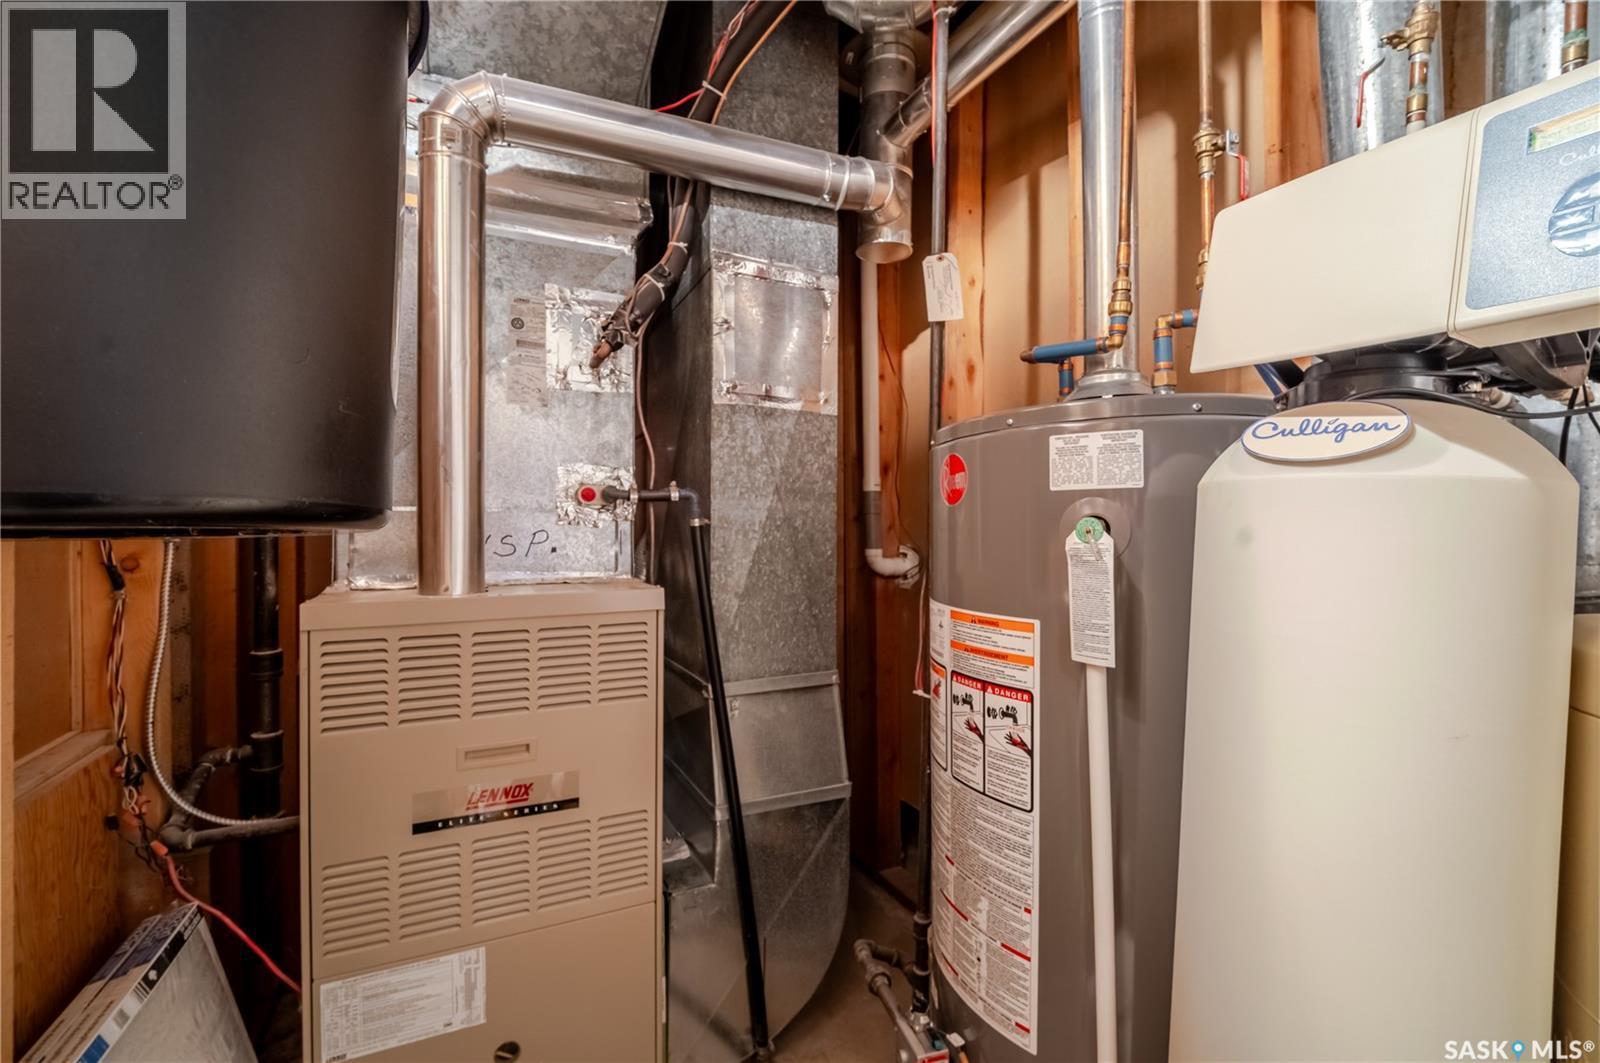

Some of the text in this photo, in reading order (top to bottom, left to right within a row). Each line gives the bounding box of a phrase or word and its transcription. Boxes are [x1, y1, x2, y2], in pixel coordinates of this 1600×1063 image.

[1251, 417, 1401, 443] Culligan
[485, 529, 557, 557] SP.
[958, 675, 982, 690] DANGER
[994, 688, 1030, 701] DANGER
[467, 782, 535, 806] LENNOX
